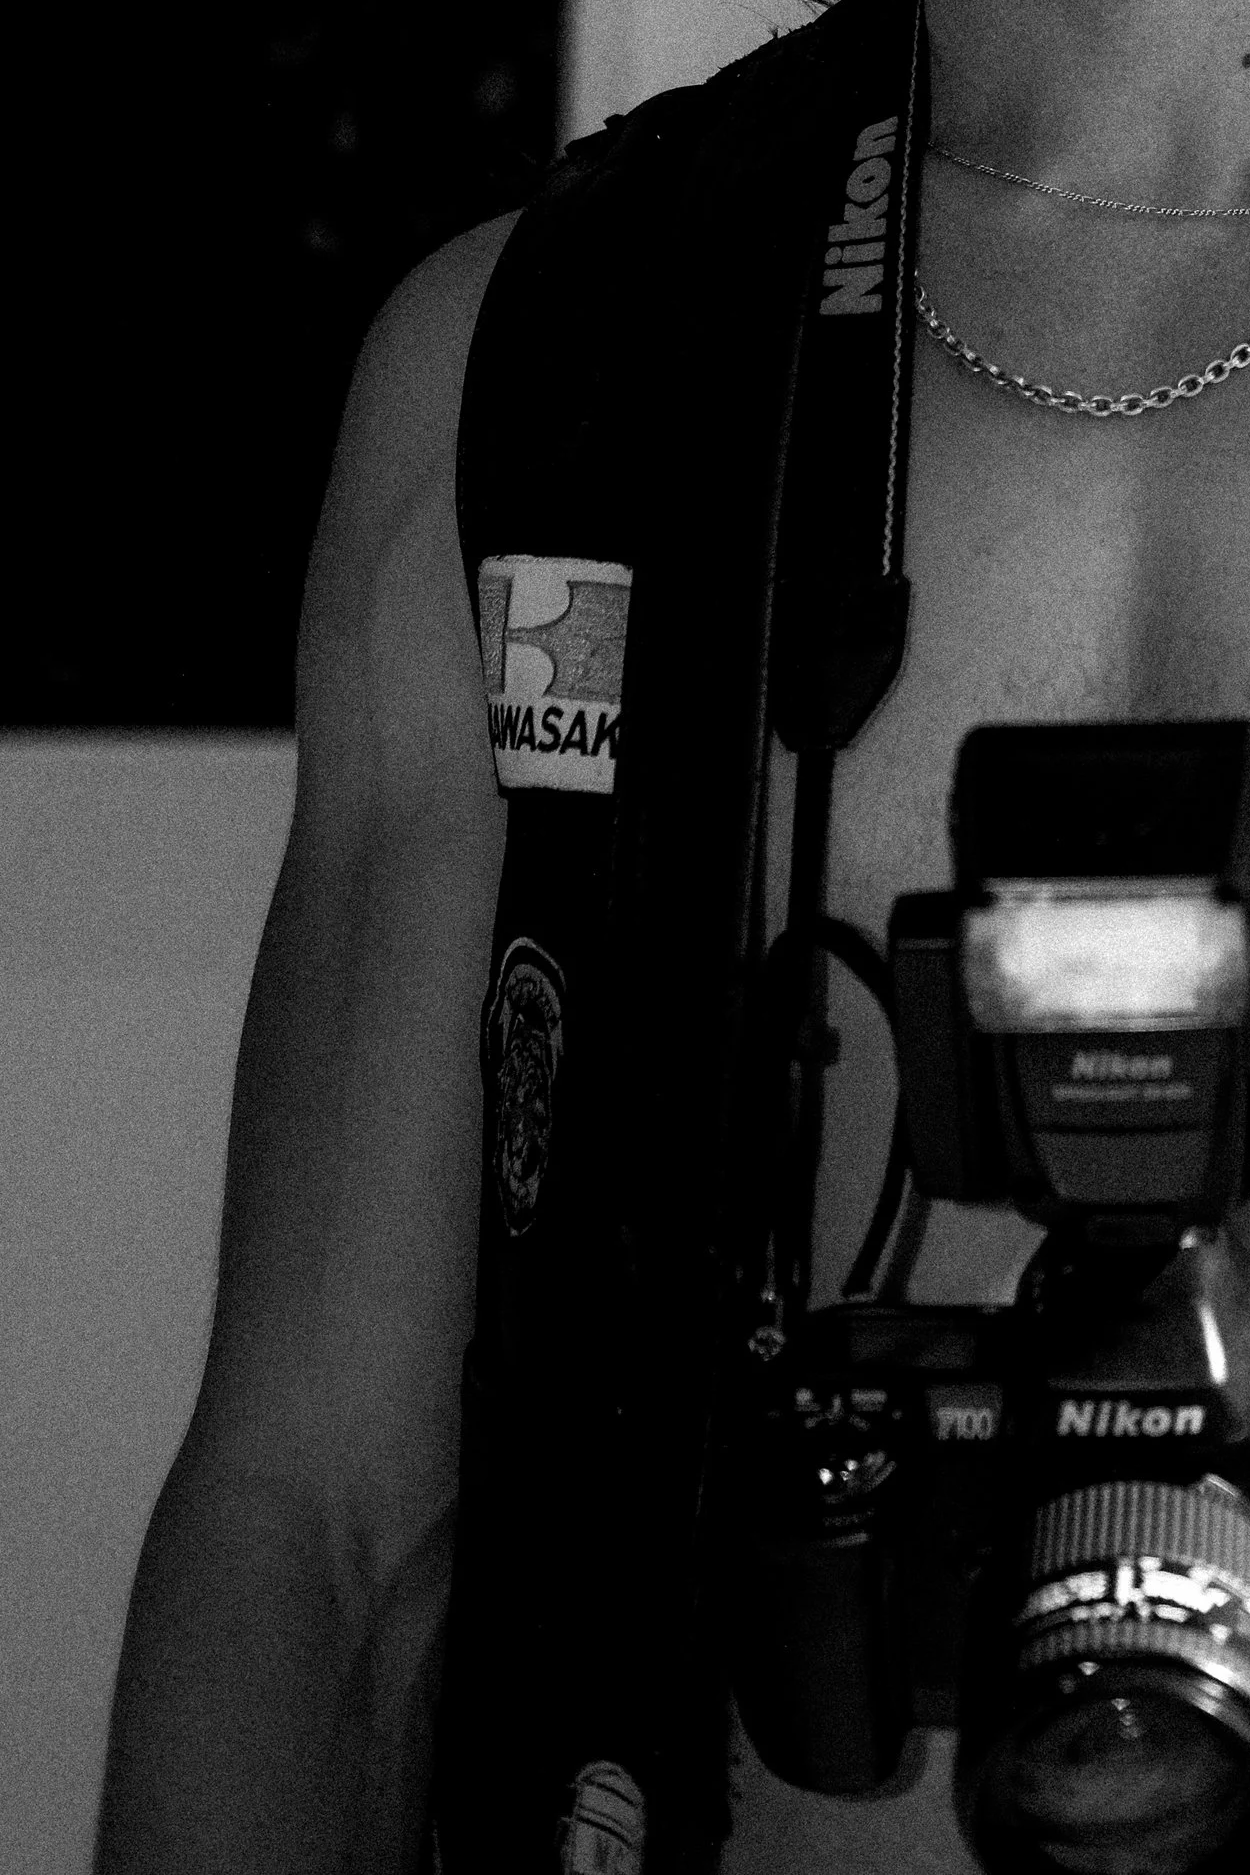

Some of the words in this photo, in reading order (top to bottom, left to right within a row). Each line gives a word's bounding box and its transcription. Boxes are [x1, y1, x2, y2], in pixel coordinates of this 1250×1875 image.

[819, 115, 899, 316] Nikon
[487, 703, 622, 759] AWASAK
[1071, 1049, 1174, 1081] Nikon
[1056, 1398, 1206, 1438] Nikon
